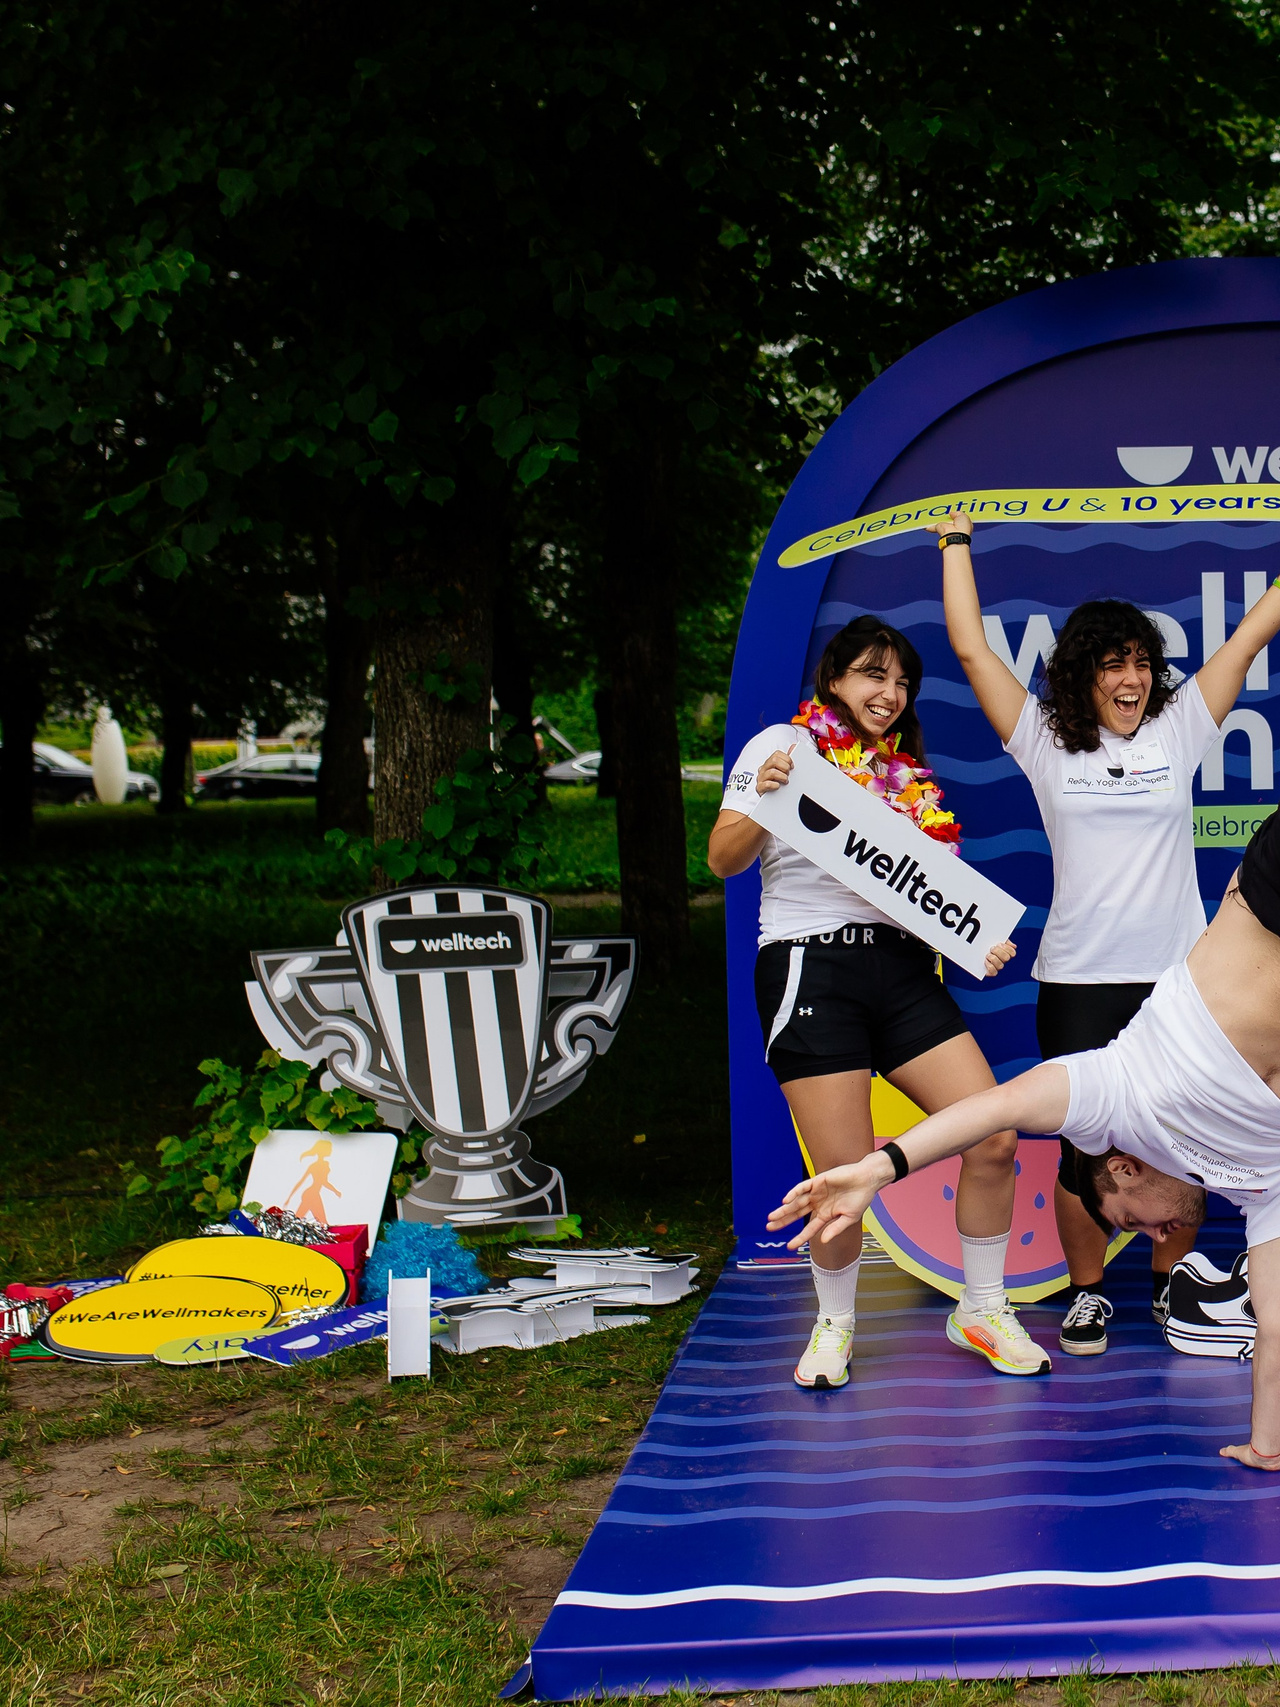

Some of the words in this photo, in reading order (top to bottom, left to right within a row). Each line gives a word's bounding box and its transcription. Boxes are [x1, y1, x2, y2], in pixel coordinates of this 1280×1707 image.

[808, 498, 1029, 552] Celebrating
[1042, 497, 1071, 512] U
[1080, 497, 1107, 512] &
[1120, 496, 1158, 512] 10
[842, 828, 982, 945] welltech
[421, 930, 512, 952] welltech
[54, 1306, 267, 1325] #WeAreWellmakers
